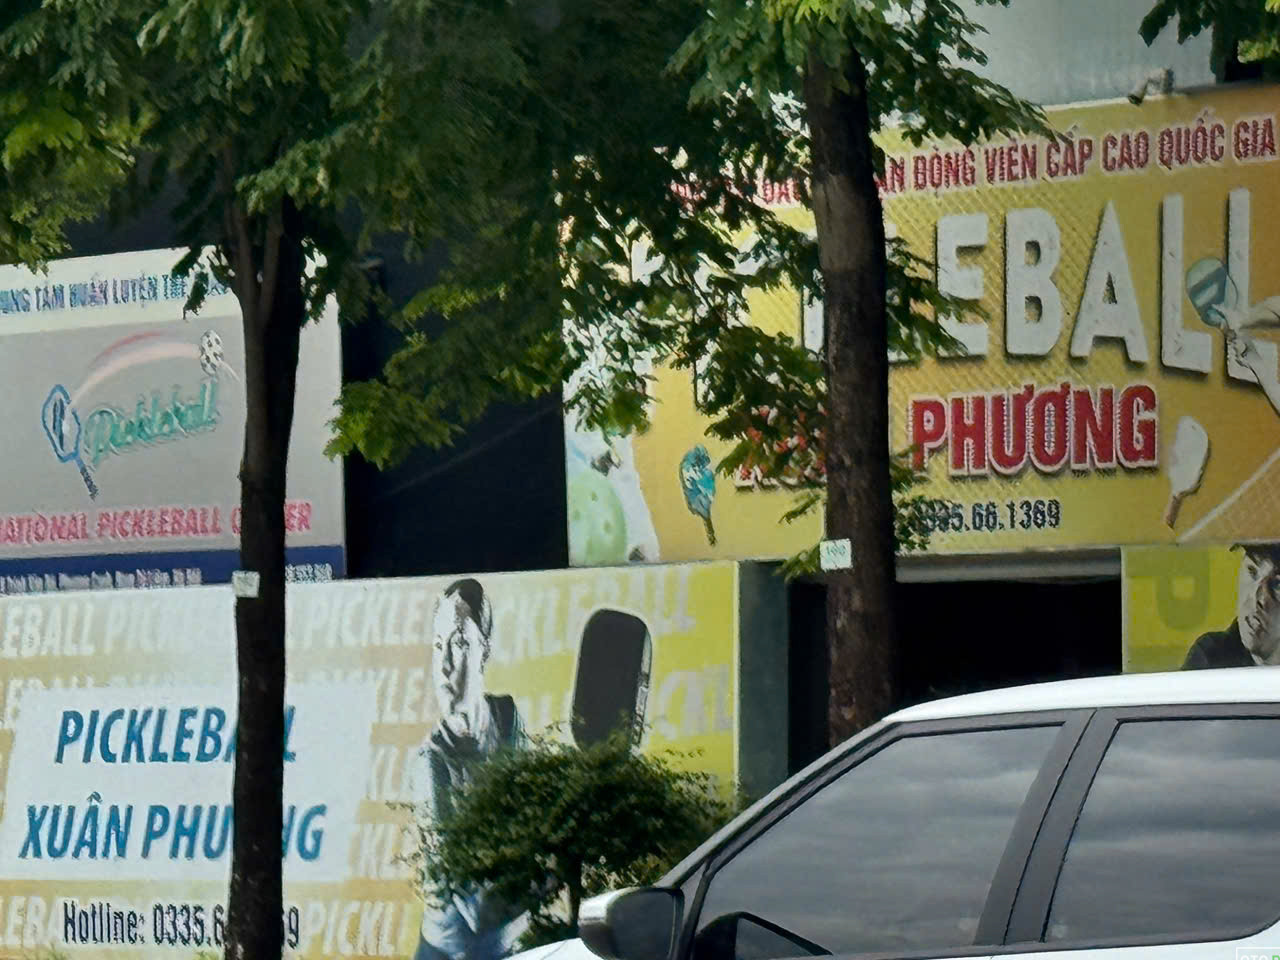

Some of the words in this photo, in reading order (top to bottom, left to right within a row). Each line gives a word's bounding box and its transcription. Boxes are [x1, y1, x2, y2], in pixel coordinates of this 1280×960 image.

[1101, 131, 1149, 172] CAO
[1157, 110, 1225, 170] QUỐC
[1233, 117, 1276, 160] GIA
[909, 382, 1159, 475] PHƯƠNG
[18, 791, 133, 859] XUÂN
[63, 900, 145, 945] Hotline:
